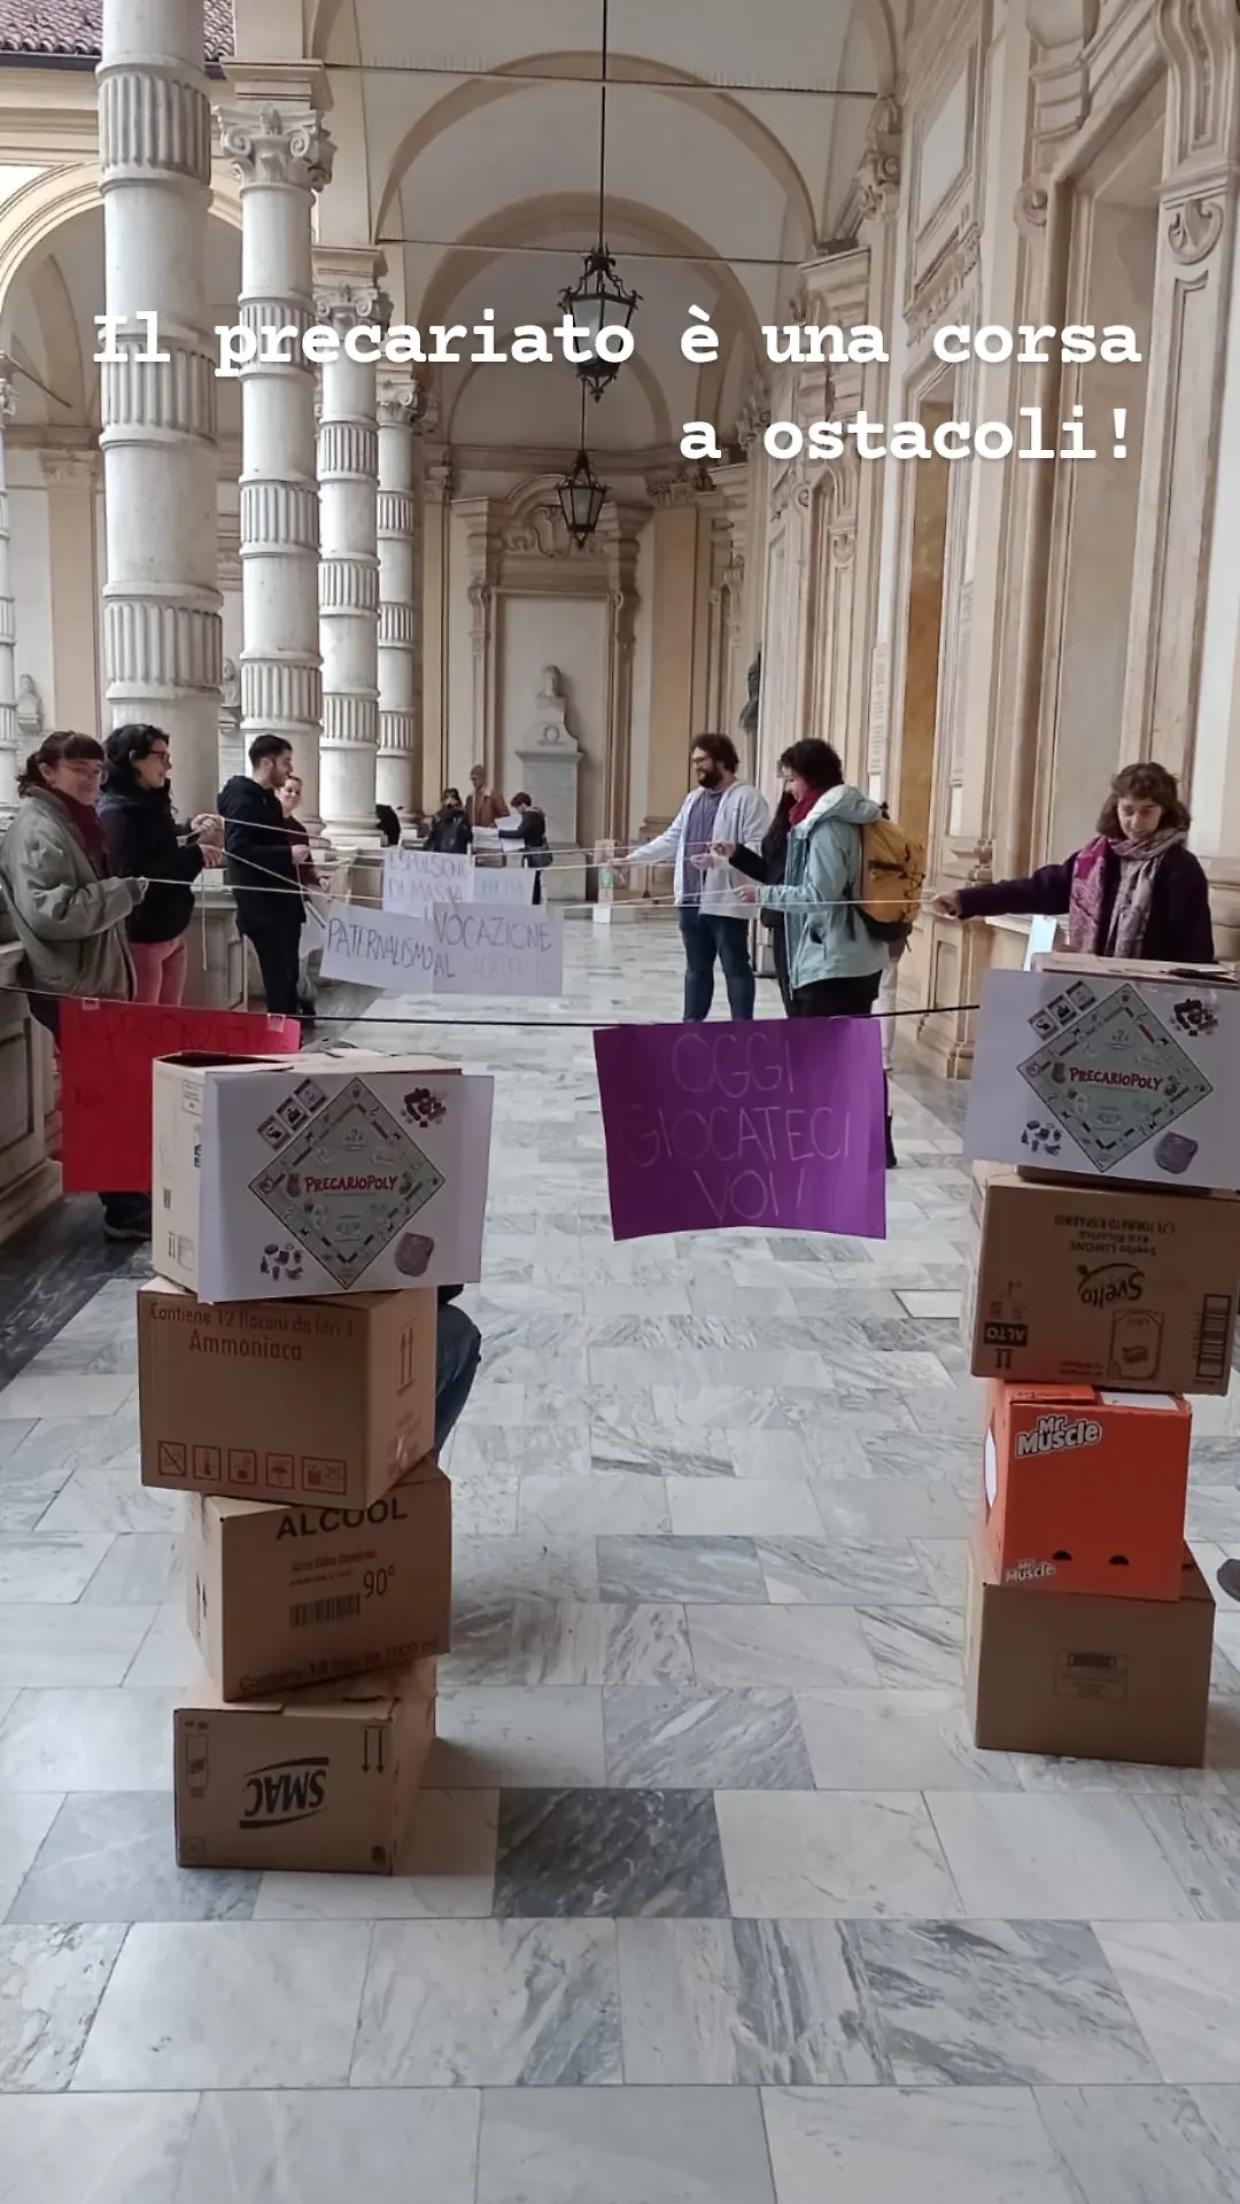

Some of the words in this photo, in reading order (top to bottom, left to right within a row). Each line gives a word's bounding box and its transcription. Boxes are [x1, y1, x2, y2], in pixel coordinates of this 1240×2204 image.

[433, 910, 552, 952] VOCAZIONE
[433, 953, 455, 978] AL
[672, 1032, 794, 1098] OGGI
[619, 1104, 850, 1167] GIOCATECI
[1081, 1268, 1145, 1309] Svelto
[150, 1301, 211, 1327] Contiene
[218, 1307, 235, 1327] 12
[986, 1326, 1025, 1342] ALTO
[189, 1328, 303, 1362] Ammoniaca
[1016, 1421, 1101, 1456] Muscle
[276, 1497, 408, 1541] ALCOOL
[244, 1768, 328, 1818] SMAC
